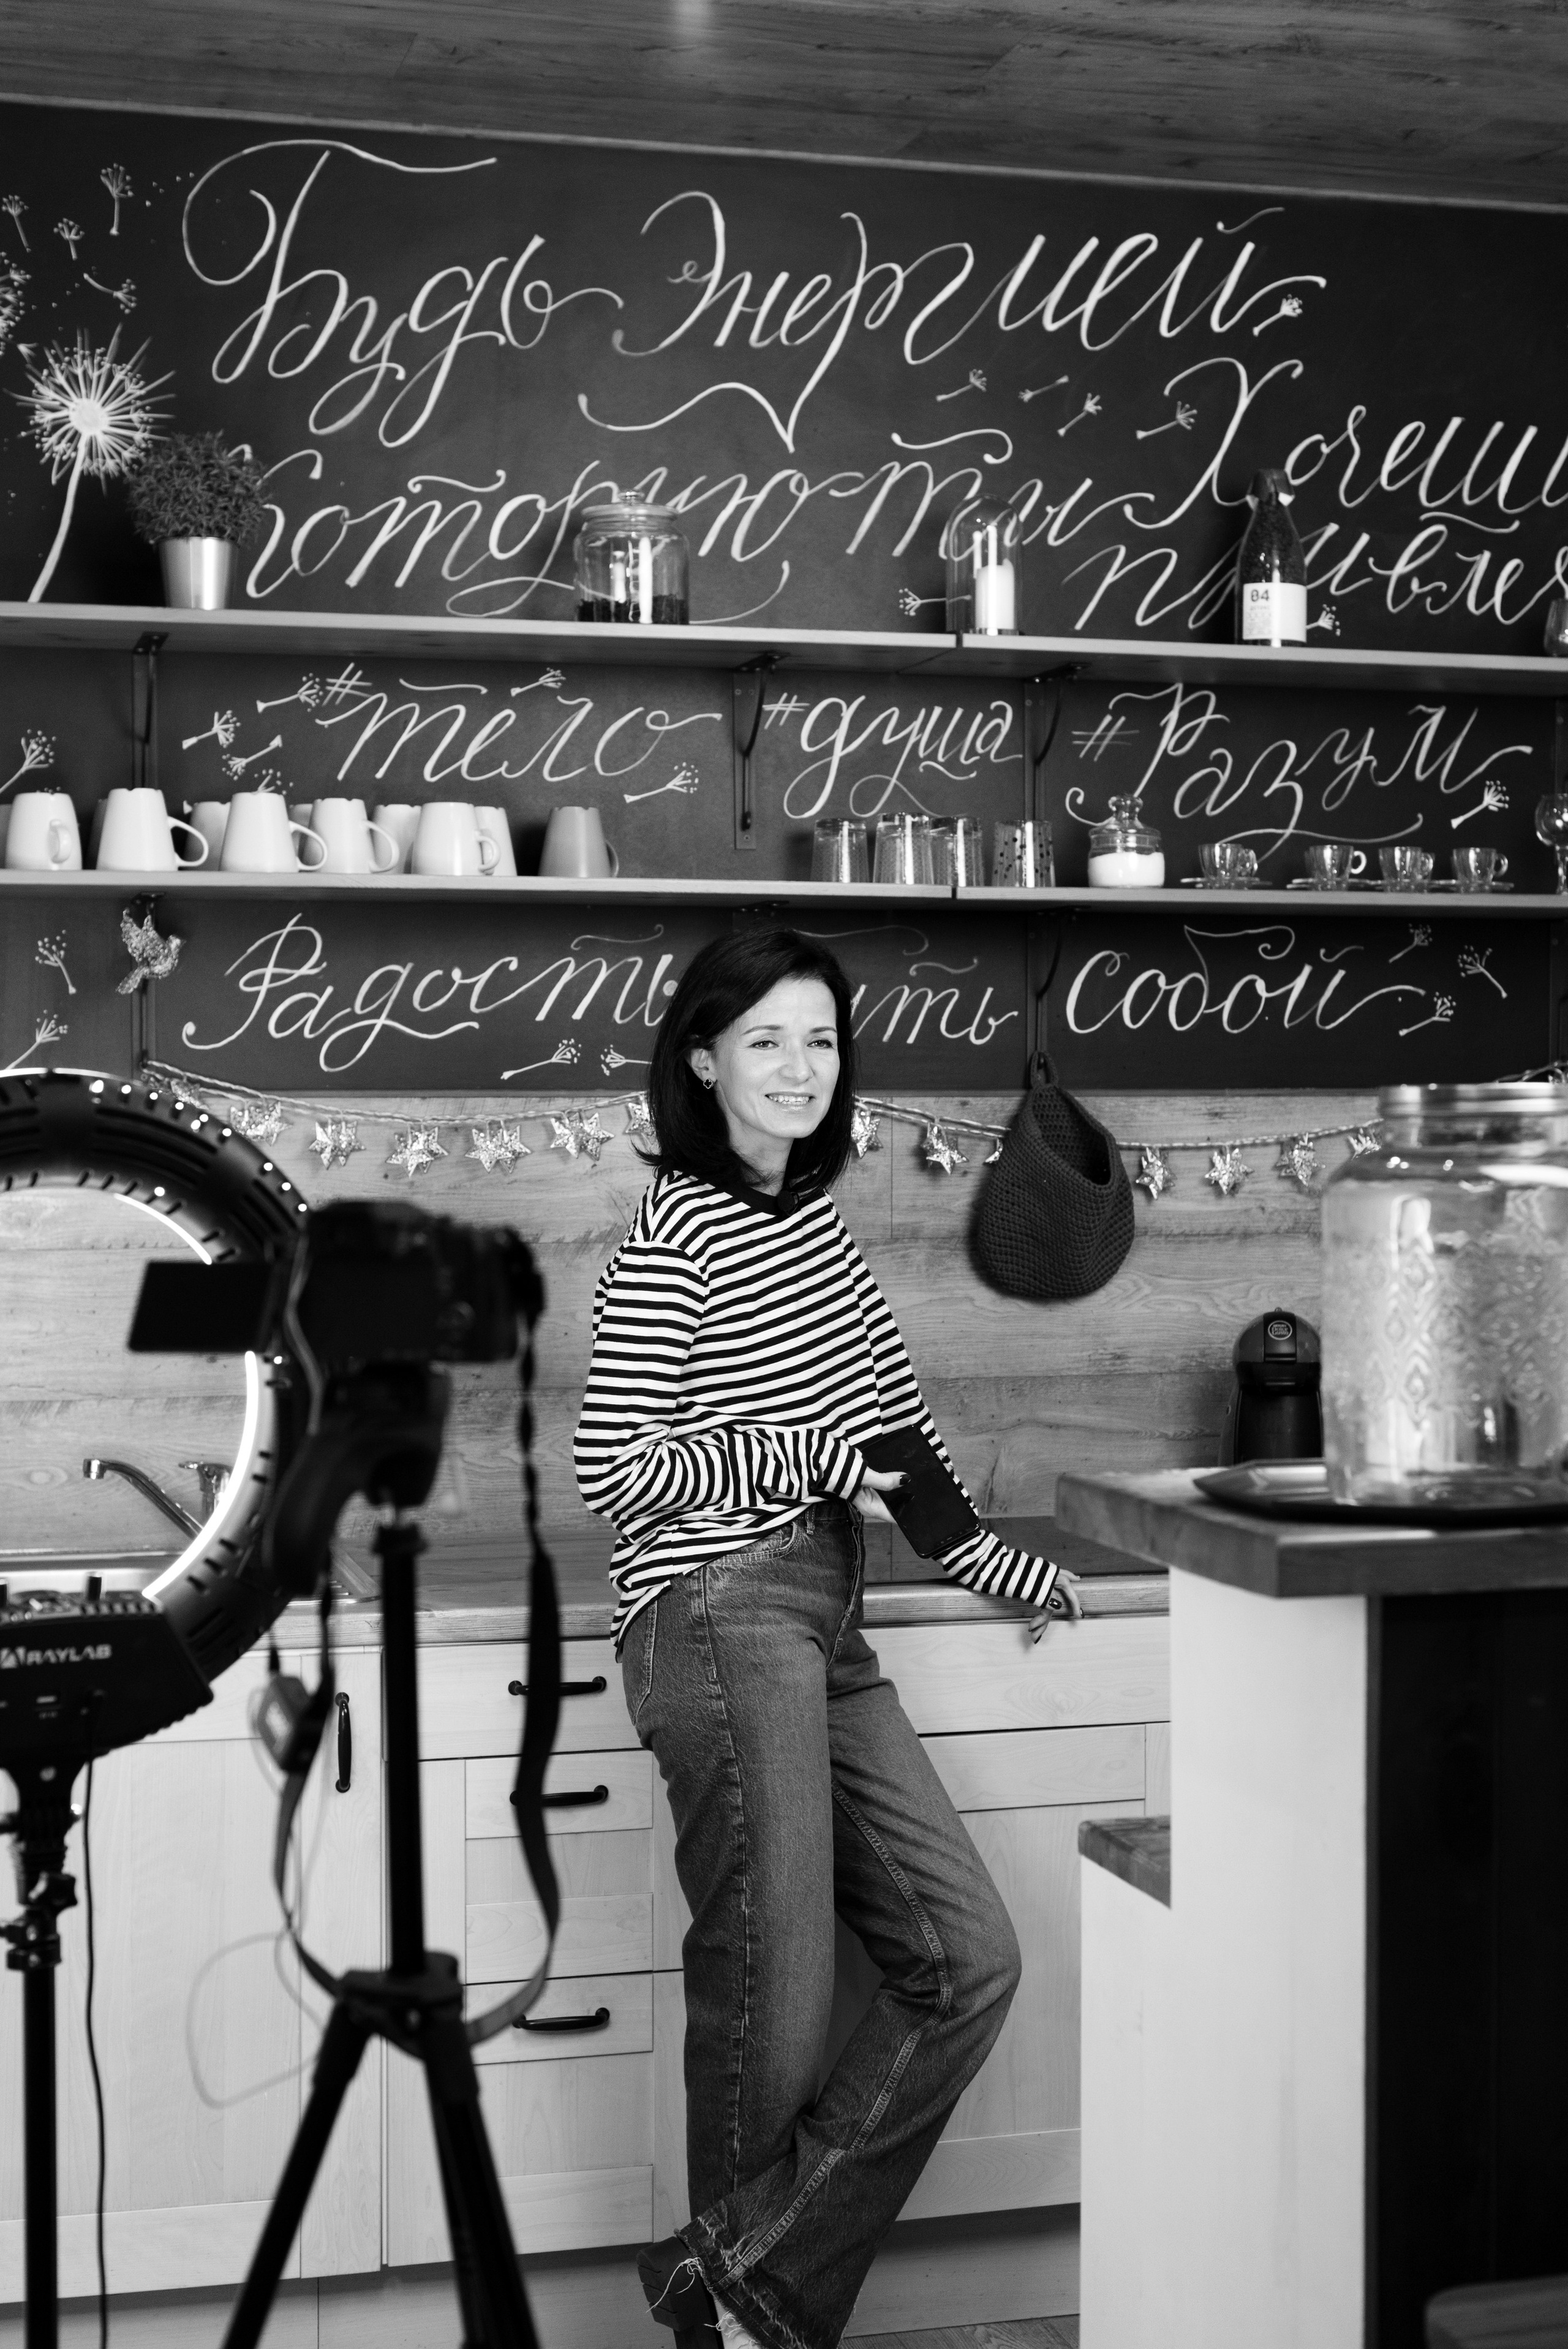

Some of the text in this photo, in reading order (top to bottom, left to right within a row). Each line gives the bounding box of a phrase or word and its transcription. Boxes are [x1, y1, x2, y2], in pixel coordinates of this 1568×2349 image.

[183, 138, 1326, 453] Будь Энергией
[1061, 523, 1568, 629] пивле
[1251, 589, 1269, 602] 04
[315, 662, 722, 782] #тело
[764, 694, 1023, 818] #душа
[796, 925, 1019, 1045] ть
[27, 1644, 112, 1666] RAYLAB
